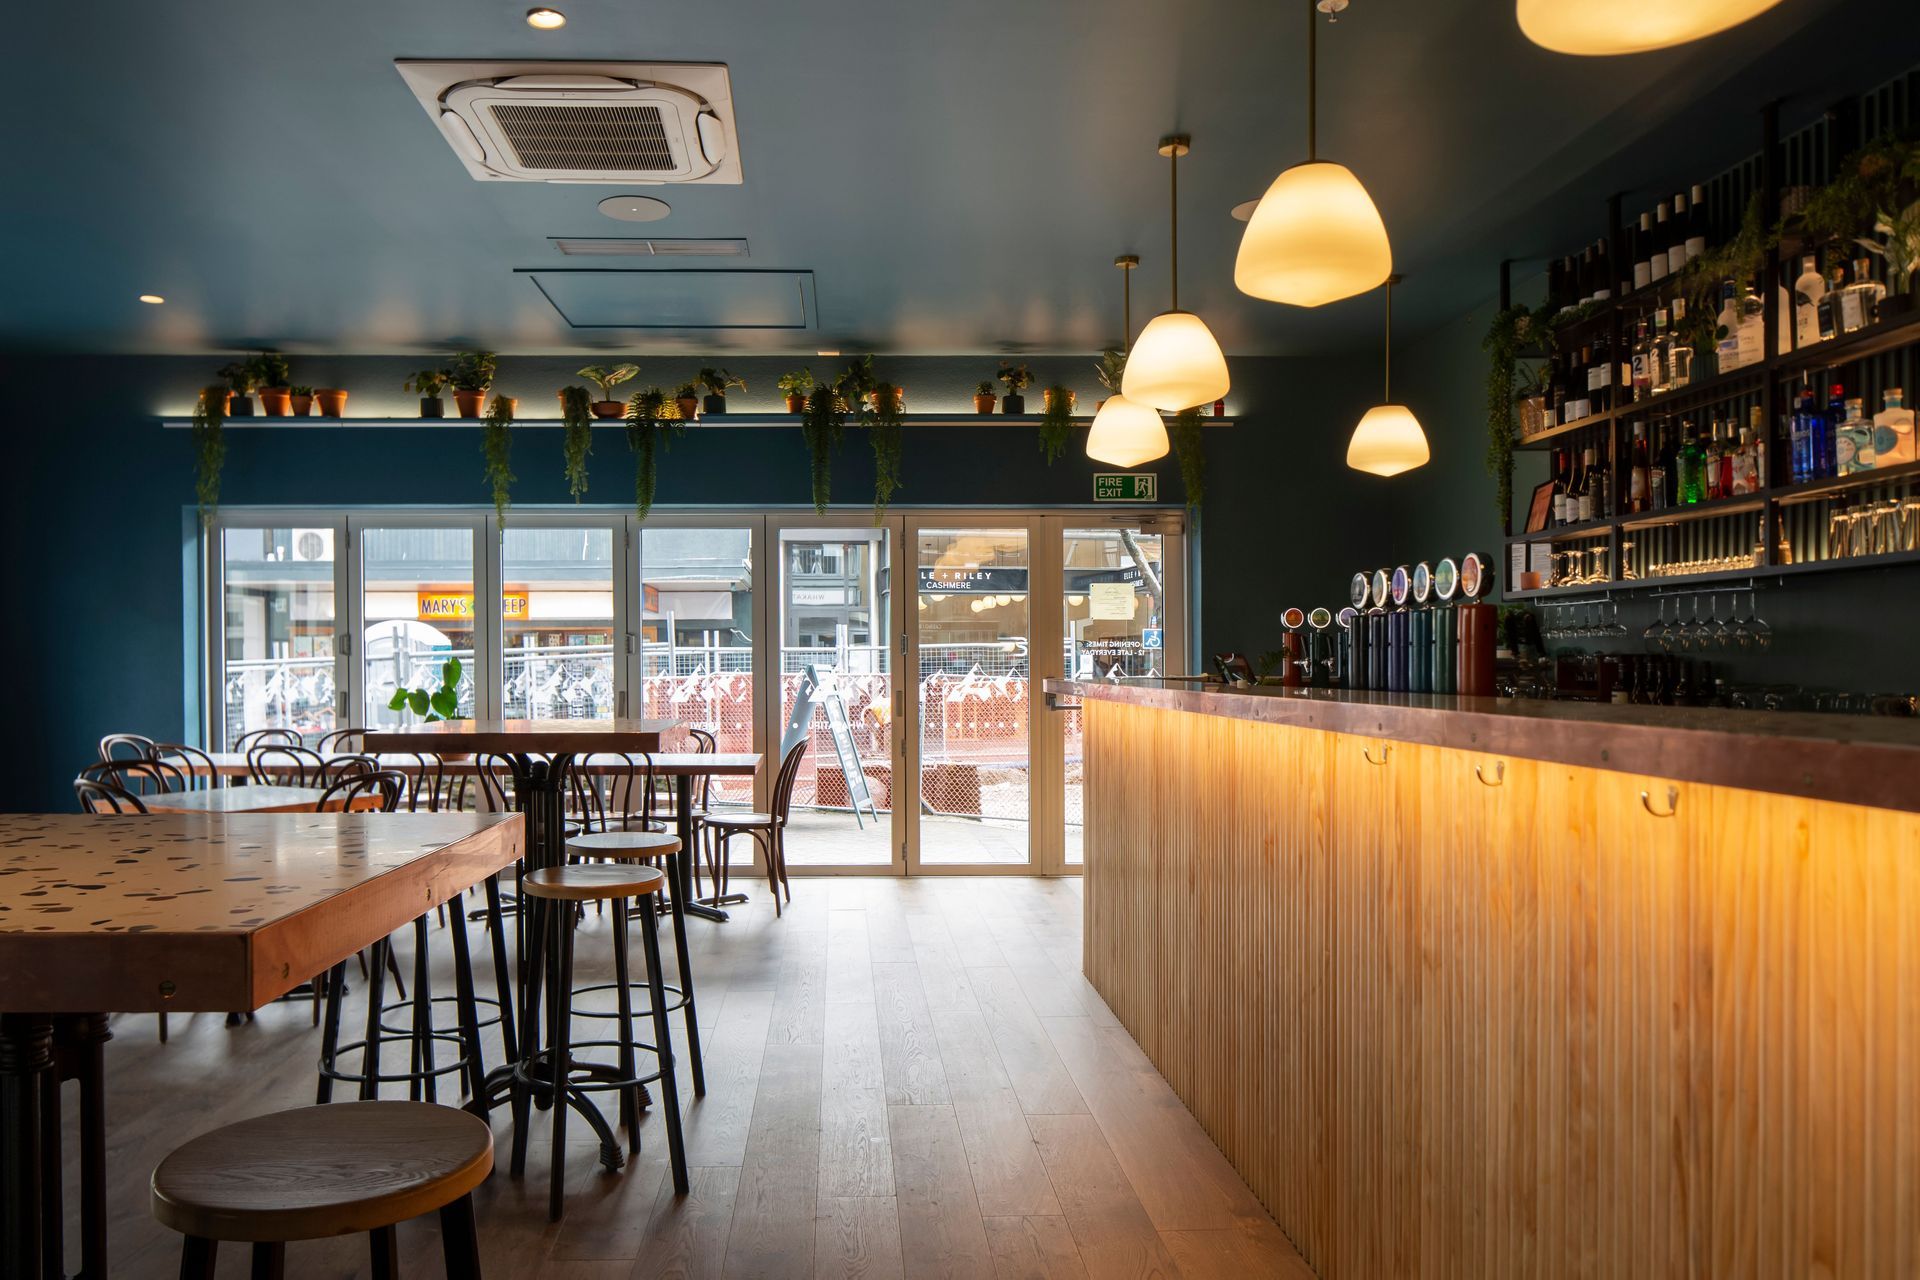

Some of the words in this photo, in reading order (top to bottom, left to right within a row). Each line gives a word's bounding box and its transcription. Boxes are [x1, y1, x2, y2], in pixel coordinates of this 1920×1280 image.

[1098, 477, 1123, 487] FIRE
[1098, 488, 1123, 497] EXIT
[921, 571, 935, 580] LE
[954, 572, 992, 580] RILEY
[926, 581, 972, 589] CASHMERE
[421, 599, 467, 614] MARY'S
[503, 598, 527, 613] EEP
